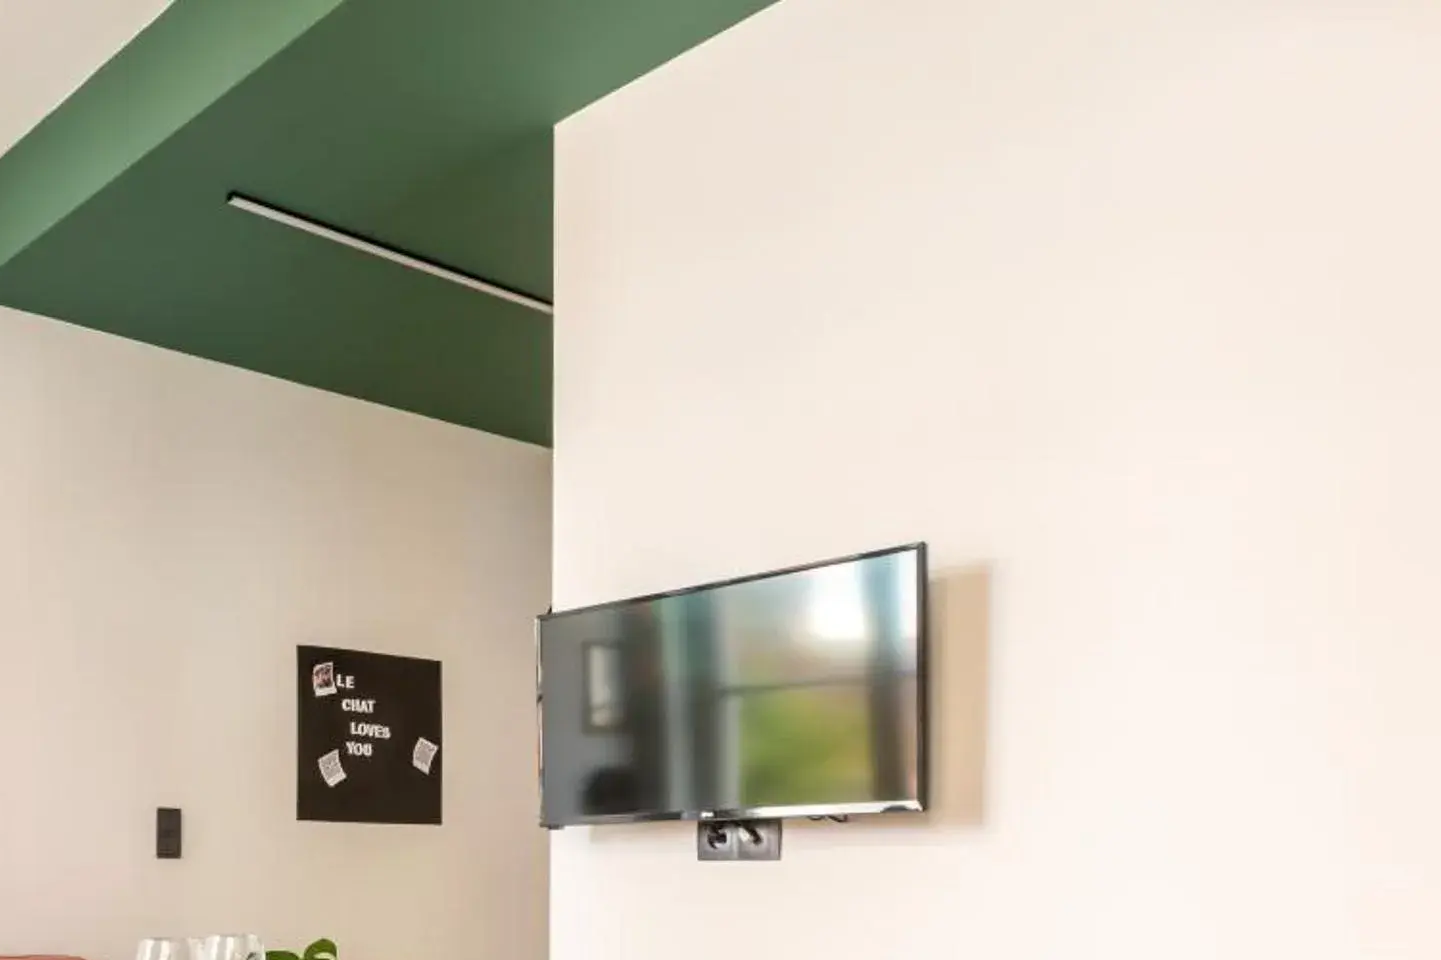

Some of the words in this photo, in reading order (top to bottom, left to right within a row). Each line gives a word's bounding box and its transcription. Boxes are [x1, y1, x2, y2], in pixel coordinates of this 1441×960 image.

[336, 674, 355, 689] LE
[342, 699, 376, 713] CHAT
[350, 722, 391, 738] LOVES
[346, 741, 372, 756] YOU
